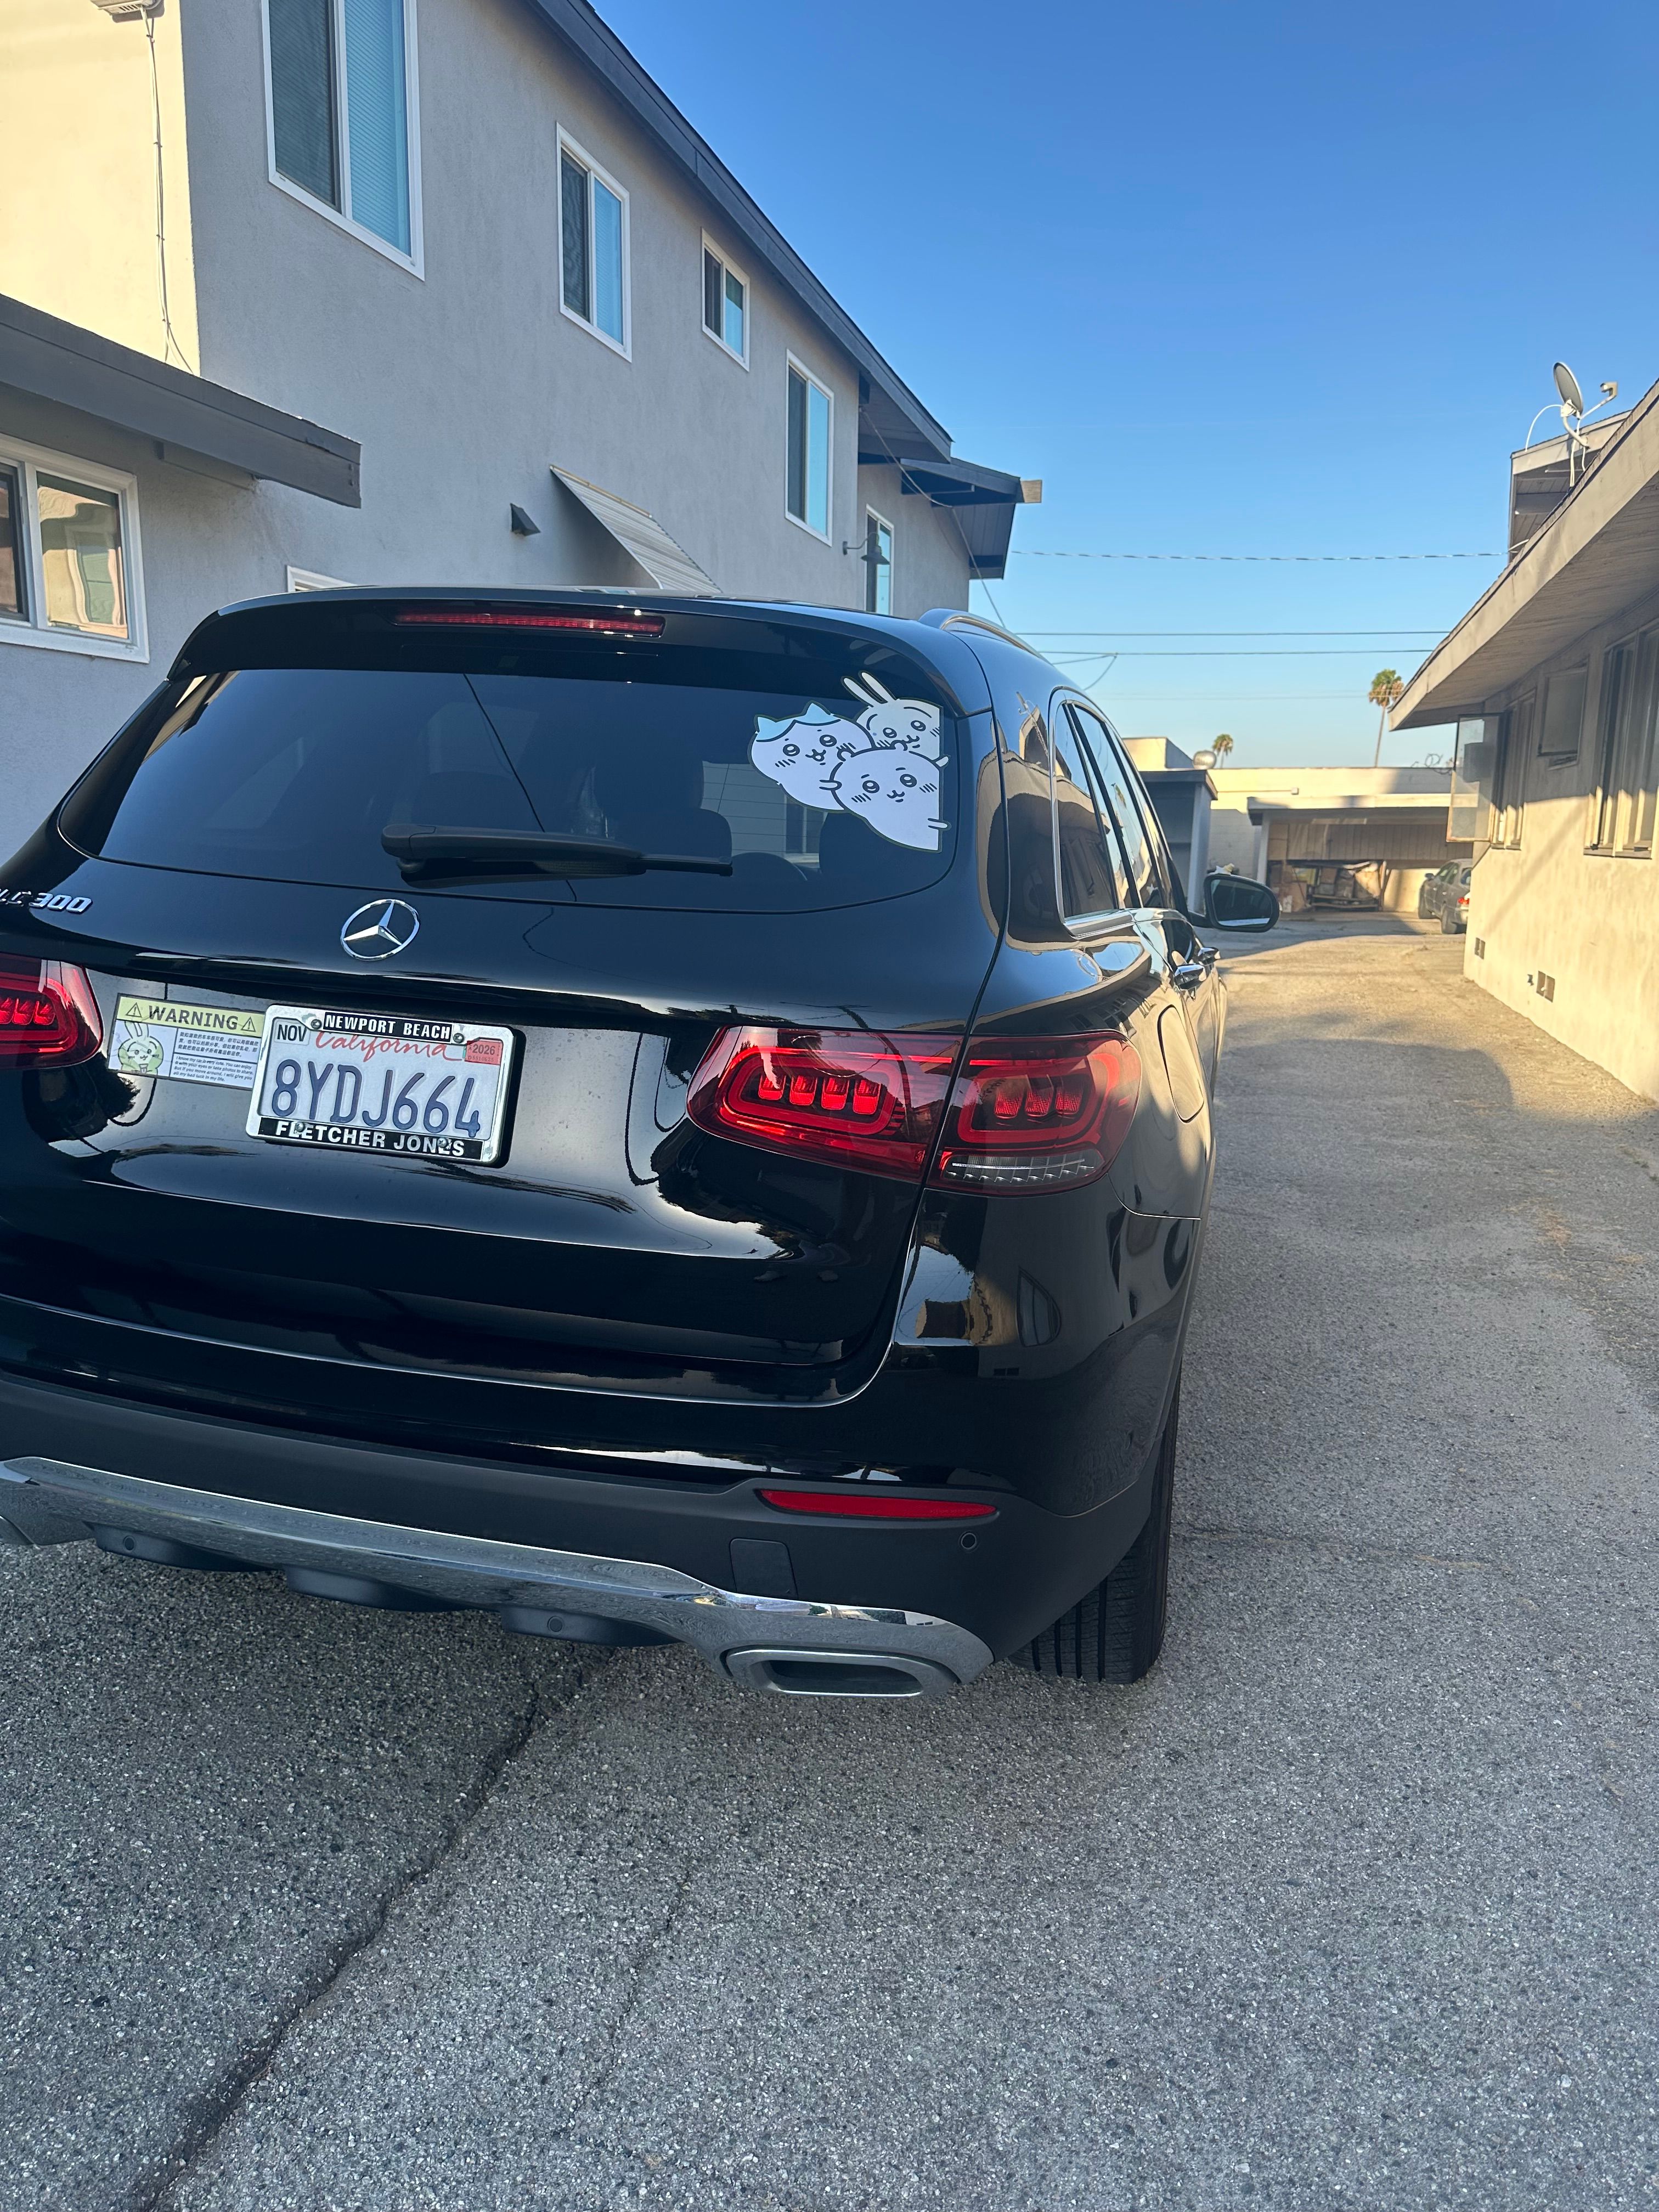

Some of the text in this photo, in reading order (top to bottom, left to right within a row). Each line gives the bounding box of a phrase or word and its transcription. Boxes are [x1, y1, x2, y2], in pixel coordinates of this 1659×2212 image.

[0, 889, 92, 912] LC 300
[149, 1005, 239, 1030] WARNING
[325, 1015, 450, 1040] NEWPORT BEACH
[277, 1024, 307, 1042] NOV
[315, 1031, 462, 1062] California
[472, 1044, 495, 1055] 2026
[272, 1059, 481, 1138] 8YDJ664
[275, 1120, 386, 1148] FLETCHER
